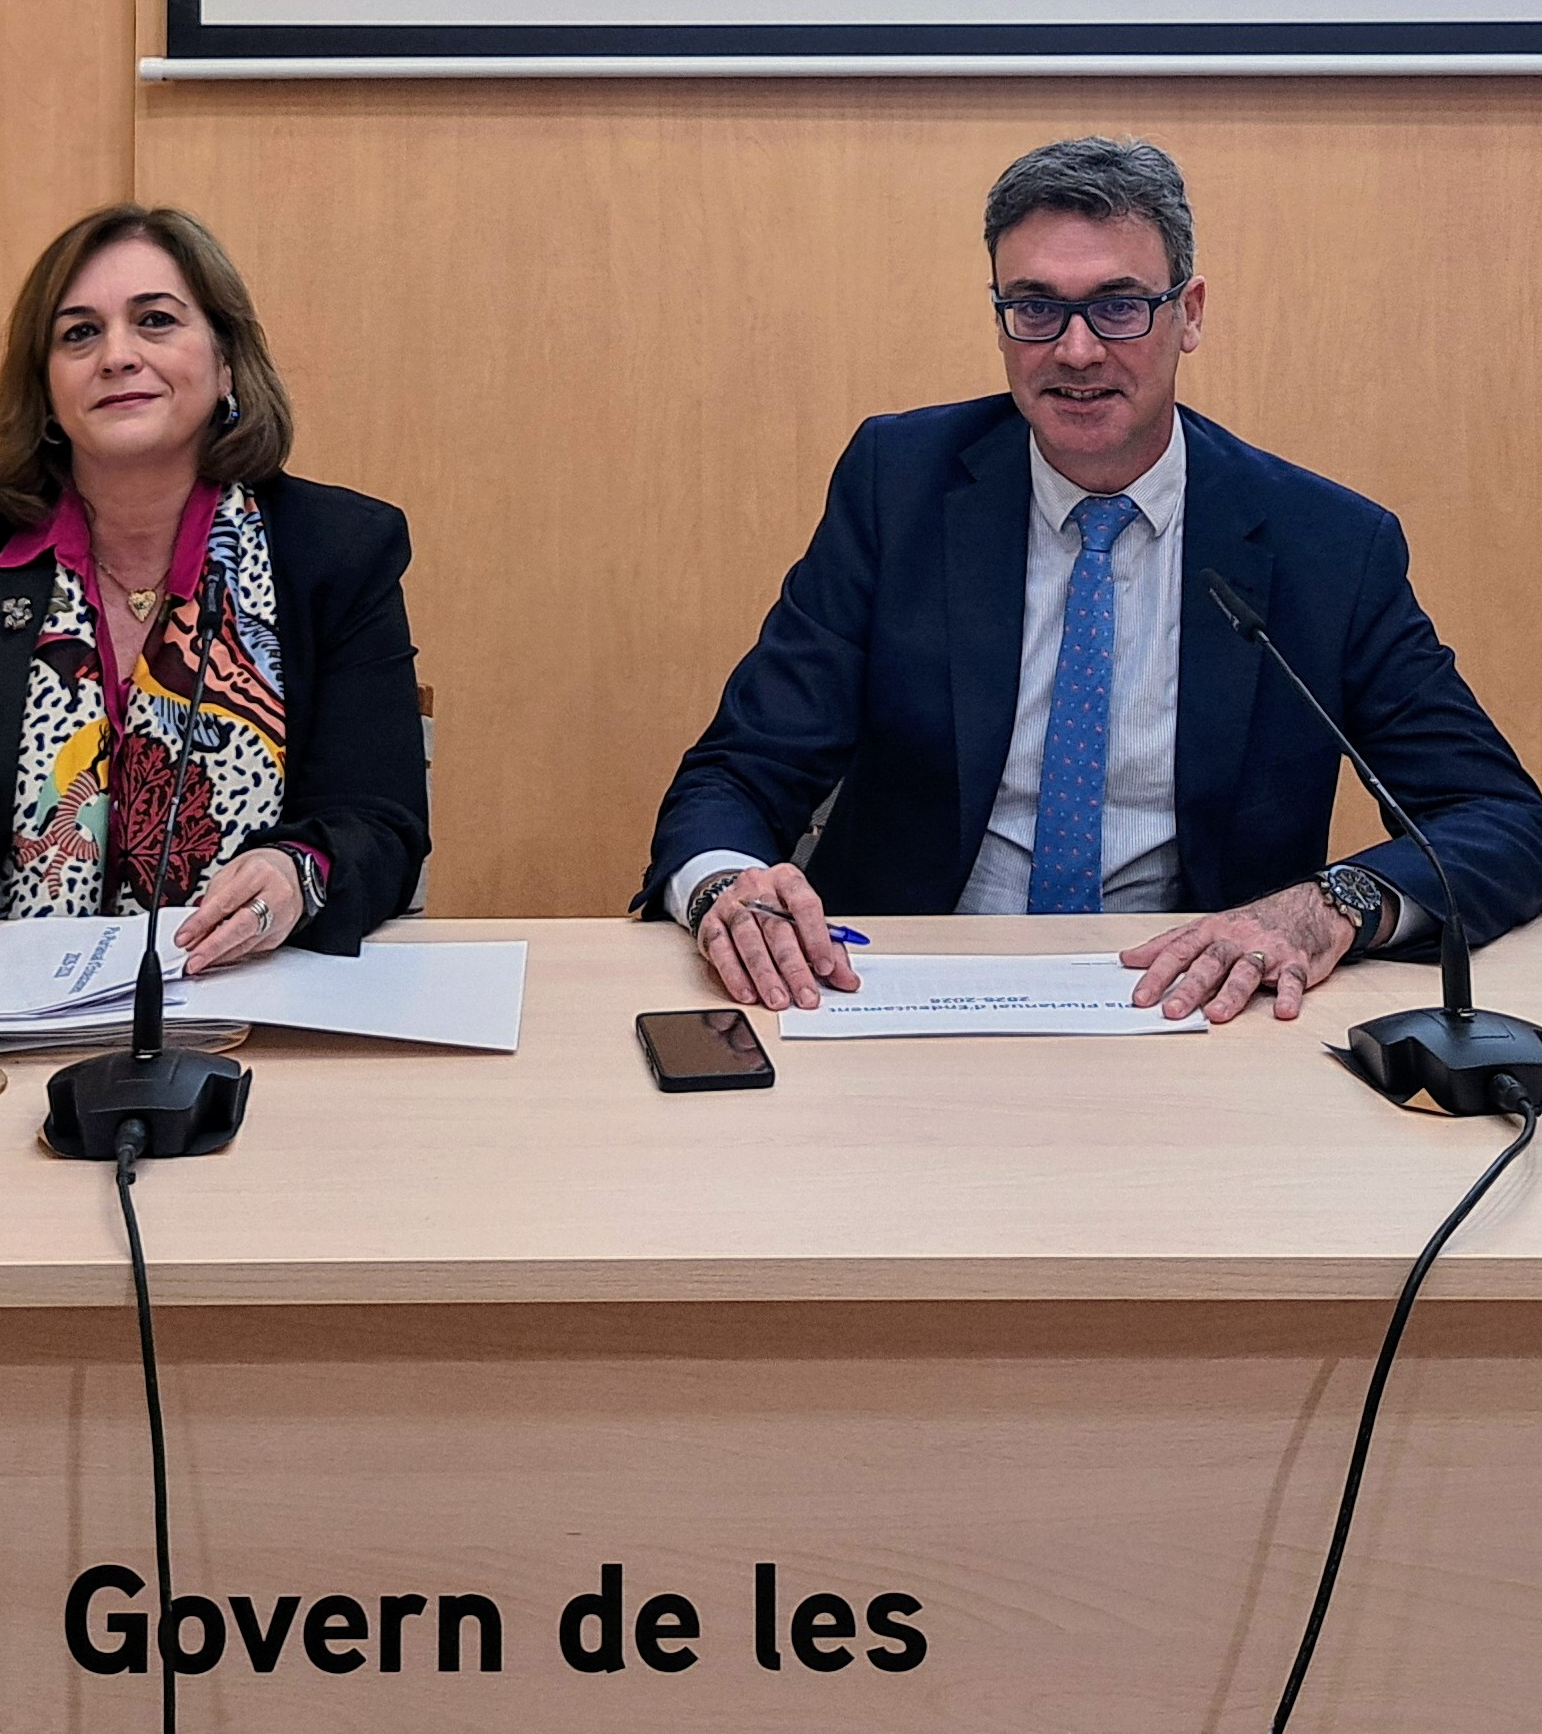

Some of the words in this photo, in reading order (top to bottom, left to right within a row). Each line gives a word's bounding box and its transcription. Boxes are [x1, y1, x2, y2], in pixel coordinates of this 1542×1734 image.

[63, 1562, 504, 1675] Govern
[558, 1563, 701, 1674] de
[755, 1562, 928, 1673] les
